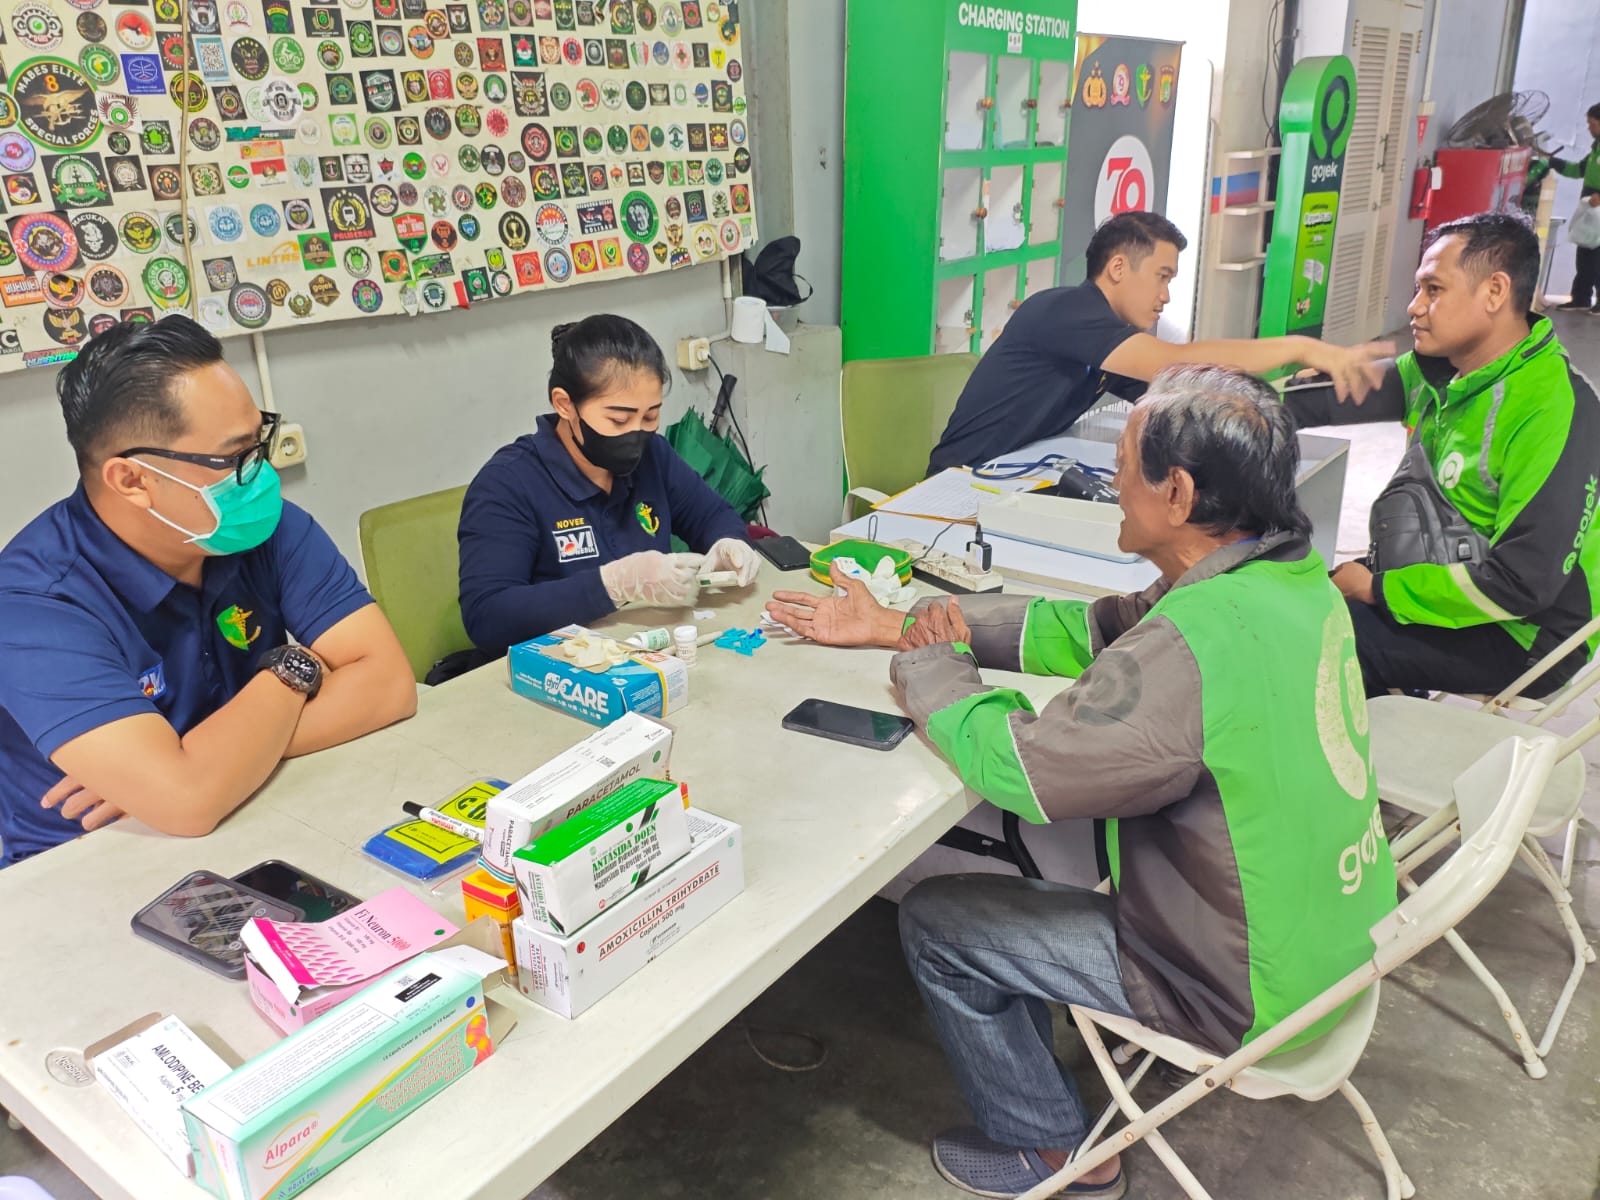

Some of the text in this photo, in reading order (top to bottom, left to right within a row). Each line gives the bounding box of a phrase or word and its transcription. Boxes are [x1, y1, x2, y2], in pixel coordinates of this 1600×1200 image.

[958, 3, 1070, 39] CHARGING STATION
[16, 64, 85, 93] MABES ELITE
[24, 108, 99, 146] SPECIAL FORCES
[1107, 157, 1146, 214] 70
[1311, 162, 1337, 183] gojek
[556, 518, 585, 529] NOVEE
[1573, 474, 1598, 549] gojek
[558, 678, 609, 714] CARE
[566, 763, 641, 819] PARACETAMOL
[592, 839, 632, 872] ANTASIDA
[634, 823, 656, 844] DOEN
[600, 905, 663, 957] AMOXICILLIN
[666, 864, 720, 908] TRIHYDRATE
[661, 910, 674, 921] 500
[152, 1044, 195, 1085] AMLODIPINE
[171, 1086, 184, 1096] 5
